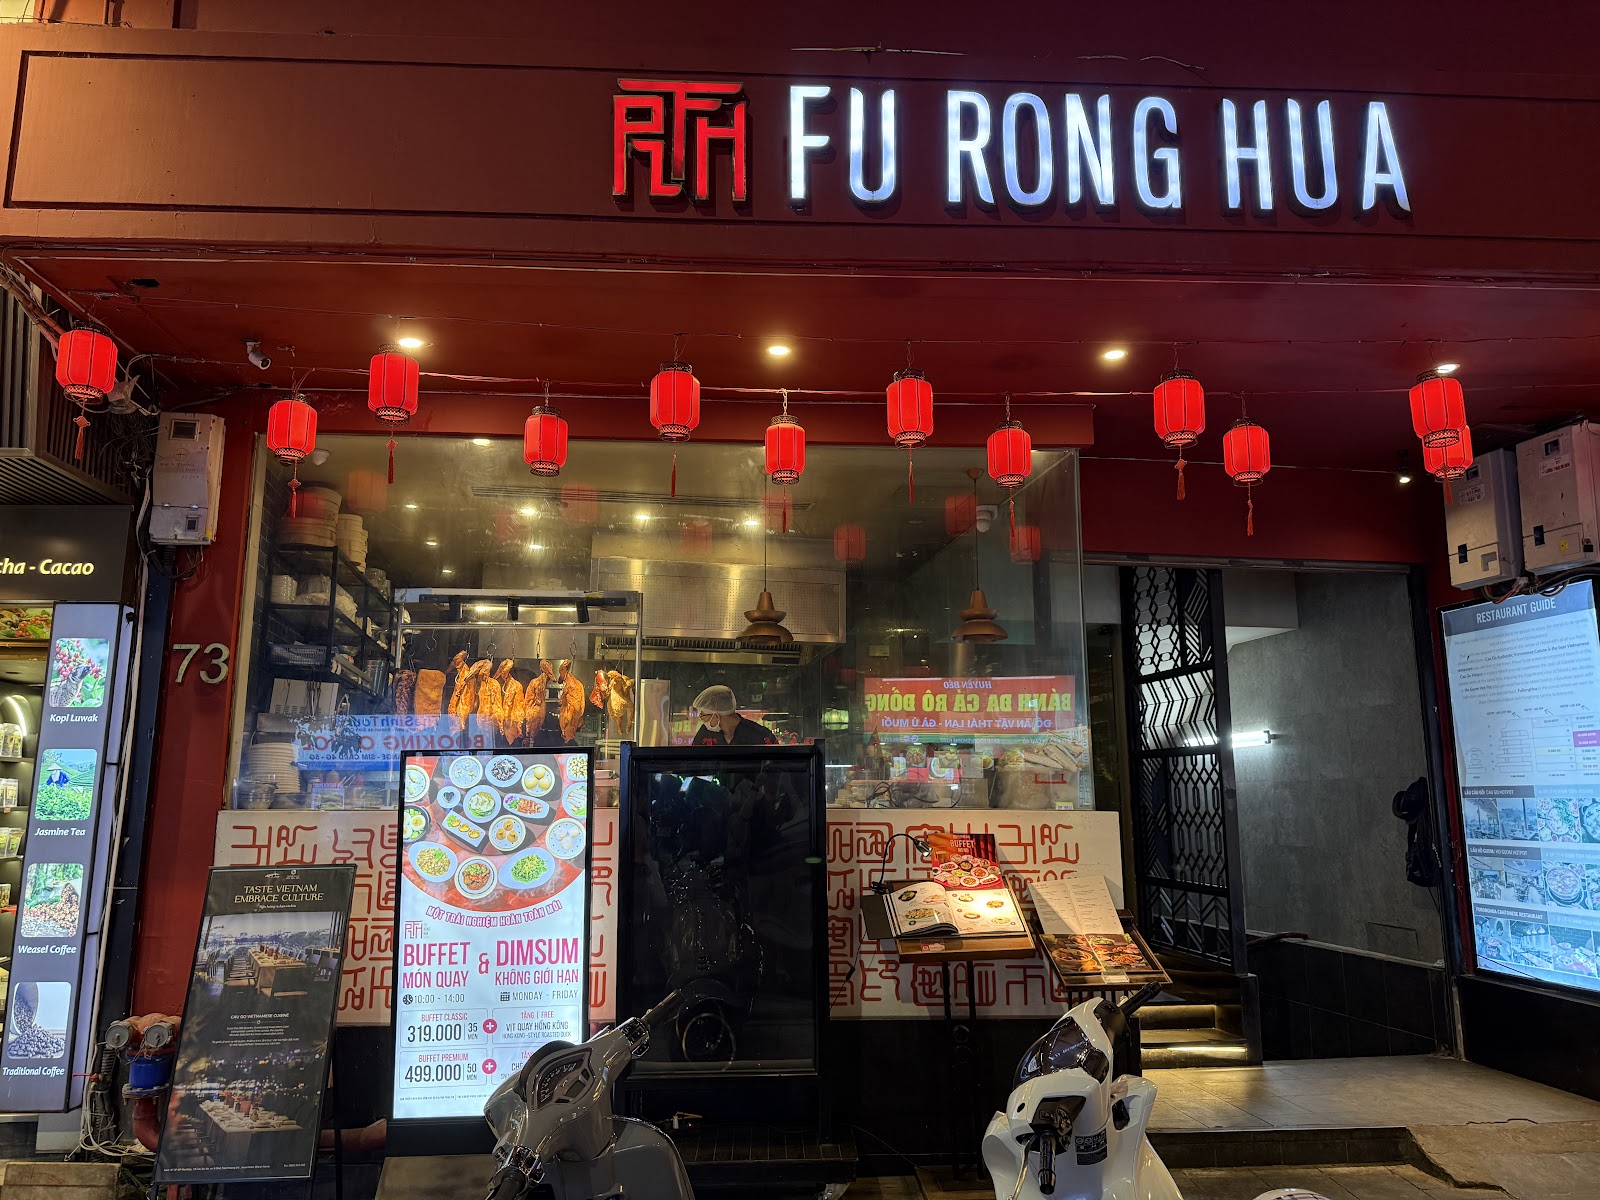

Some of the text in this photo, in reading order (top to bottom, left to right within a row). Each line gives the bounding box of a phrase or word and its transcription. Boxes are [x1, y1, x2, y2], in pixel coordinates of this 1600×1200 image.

[789, 85, 1412, 213] FU RONG HUA
[39, 558, 95, 576] Cacao
[1476, 598, 1557, 624] RESTAURANT GUIDE
[172, 643, 229, 684] 73
[70, 713, 98, 723] Luwak
[34, 827, 86, 836] Jasmine Tea
[950, 840, 975, 849] BUFFET
[244, 884, 318, 894] TASTE VIETNAM
[234, 893, 324, 904] EMBRACE CULTURE
[18, 944, 77, 955] Weasel Coffee
[403, 937, 579, 975] BUFFET & DIMSUM
[402, 969, 470, 989] MÓN QUAY
[495, 968, 579, 986] KHÔNG GIỚI HẠN
[414, 994, 435, 1004] 10:00
[444, 993, 465, 1003] 14:00
[512, 991, 544, 1001] MONDAY
[552, 989, 579, 1000] FRIDAY
[421, 1012, 468, 1022] BUFFET CLASSIC
[541, 1010, 555, 1019] FREE
[407, 1022, 462, 1043] 319.000
[467, 1022, 478, 1033] 35
[517, 1022, 534, 1032] QUAY
[418, 1052, 469, 1063] BUFFET PREMIUM
[2, 1066, 65, 1076] Traditional Coffee
[404, 1063, 462, 1083] 499.000
[466, 1062, 477, 1073] 50
